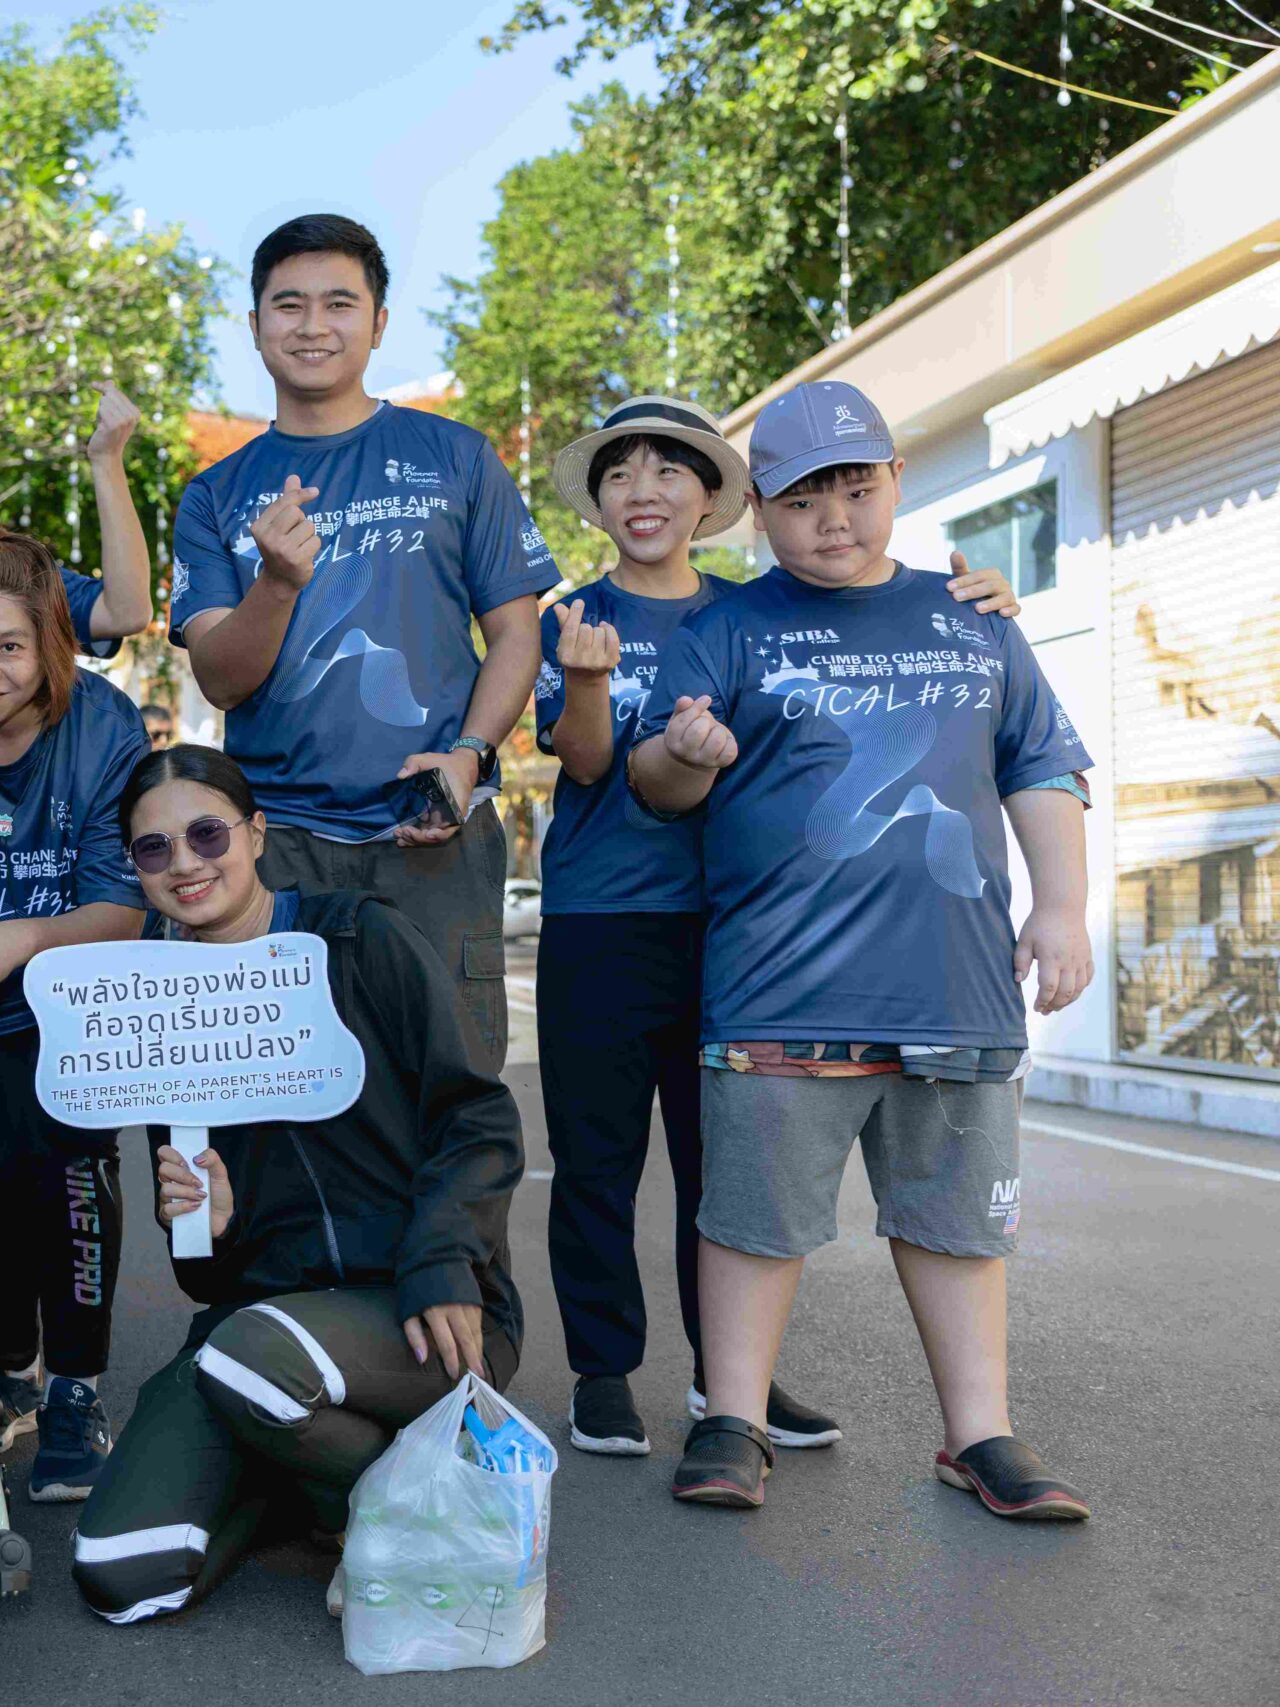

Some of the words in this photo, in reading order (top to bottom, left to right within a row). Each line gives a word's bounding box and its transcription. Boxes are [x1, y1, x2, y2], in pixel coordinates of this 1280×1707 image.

[402, 463, 417, 471] Zy
[324, 511, 343, 522] TO
[345, 496, 401, 513] CHANGE
[408, 495, 420, 506] A
[423, 496, 448, 511] LIFE
[357, 528, 425, 555] #32
[779, 628, 840, 644] SIBA
[811, 655, 860, 665] CLIMB
[864, 654, 888, 664] TO
[891, 650, 961, 663] CHANGE
[967, 653, 978, 663] A
[979, 654, 1004, 671] LIFE
[783, 683, 910, 720] CTCAL
[915, 680, 992, 709] #32
[85, 998, 282, 1041] คือจุดเริ่มของ
[51, 1089, 78, 1101] THE
[83, 1083, 157, 1098] STRENGTH
[162, 1080, 182, 1091] OF
[186, 1080, 196, 1090] A
[201, 1073, 271, 1088] PARENT'S
[276, 1068, 325, 1083] HEART
[330, 1067, 343, 1078] IS
[65, 1101, 92, 1112] THE
[97, 1094, 166, 1110] STARTING
[171, 1090, 216, 1104] POINT
[220, 1089, 240, 1100] OF
[245, 1083, 312, 1098] CHANGE.
[73, 1238, 102, 1306] PRO
